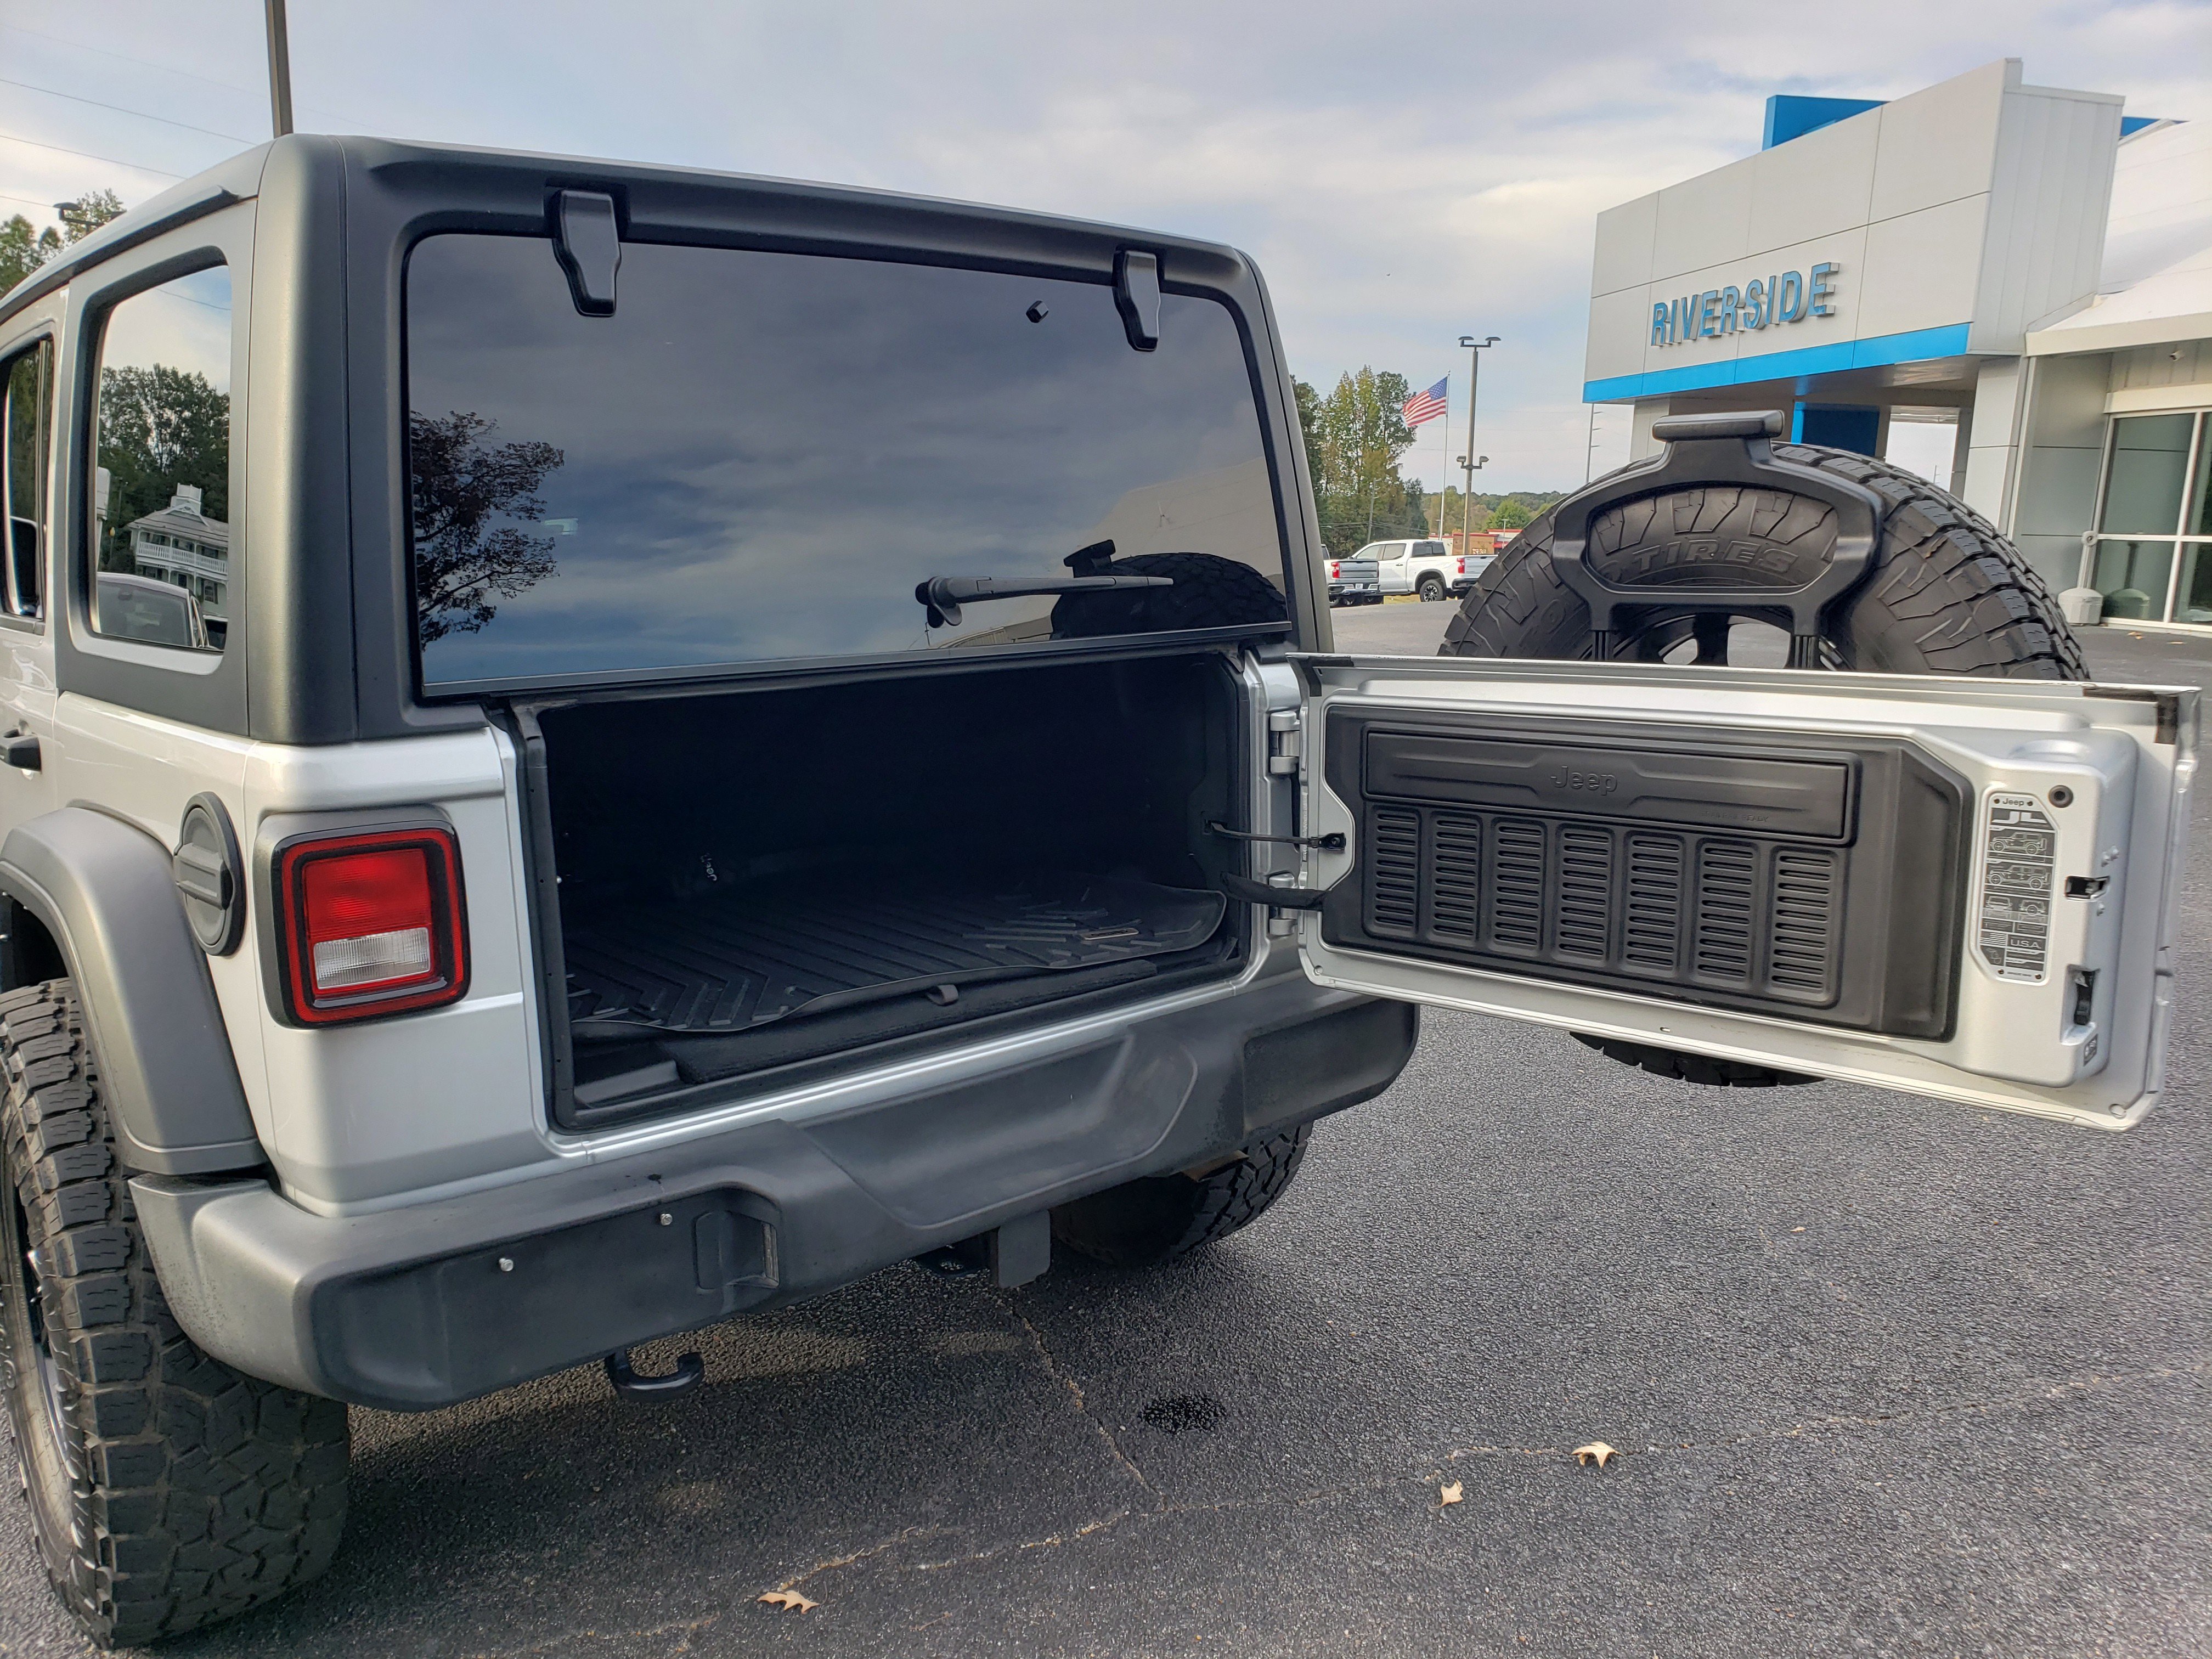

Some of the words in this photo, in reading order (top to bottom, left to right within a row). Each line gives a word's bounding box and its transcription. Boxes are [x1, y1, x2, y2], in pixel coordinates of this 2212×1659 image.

[1650, 262, 1839, 347] RIVERSIDE
[1632, 539, 1799, 574] TIRES
[1550, 765, 1618, 796] Jeep
[1991, 811, 2048, 824] JL
[2002, 798, 2024, 807] Jeep
